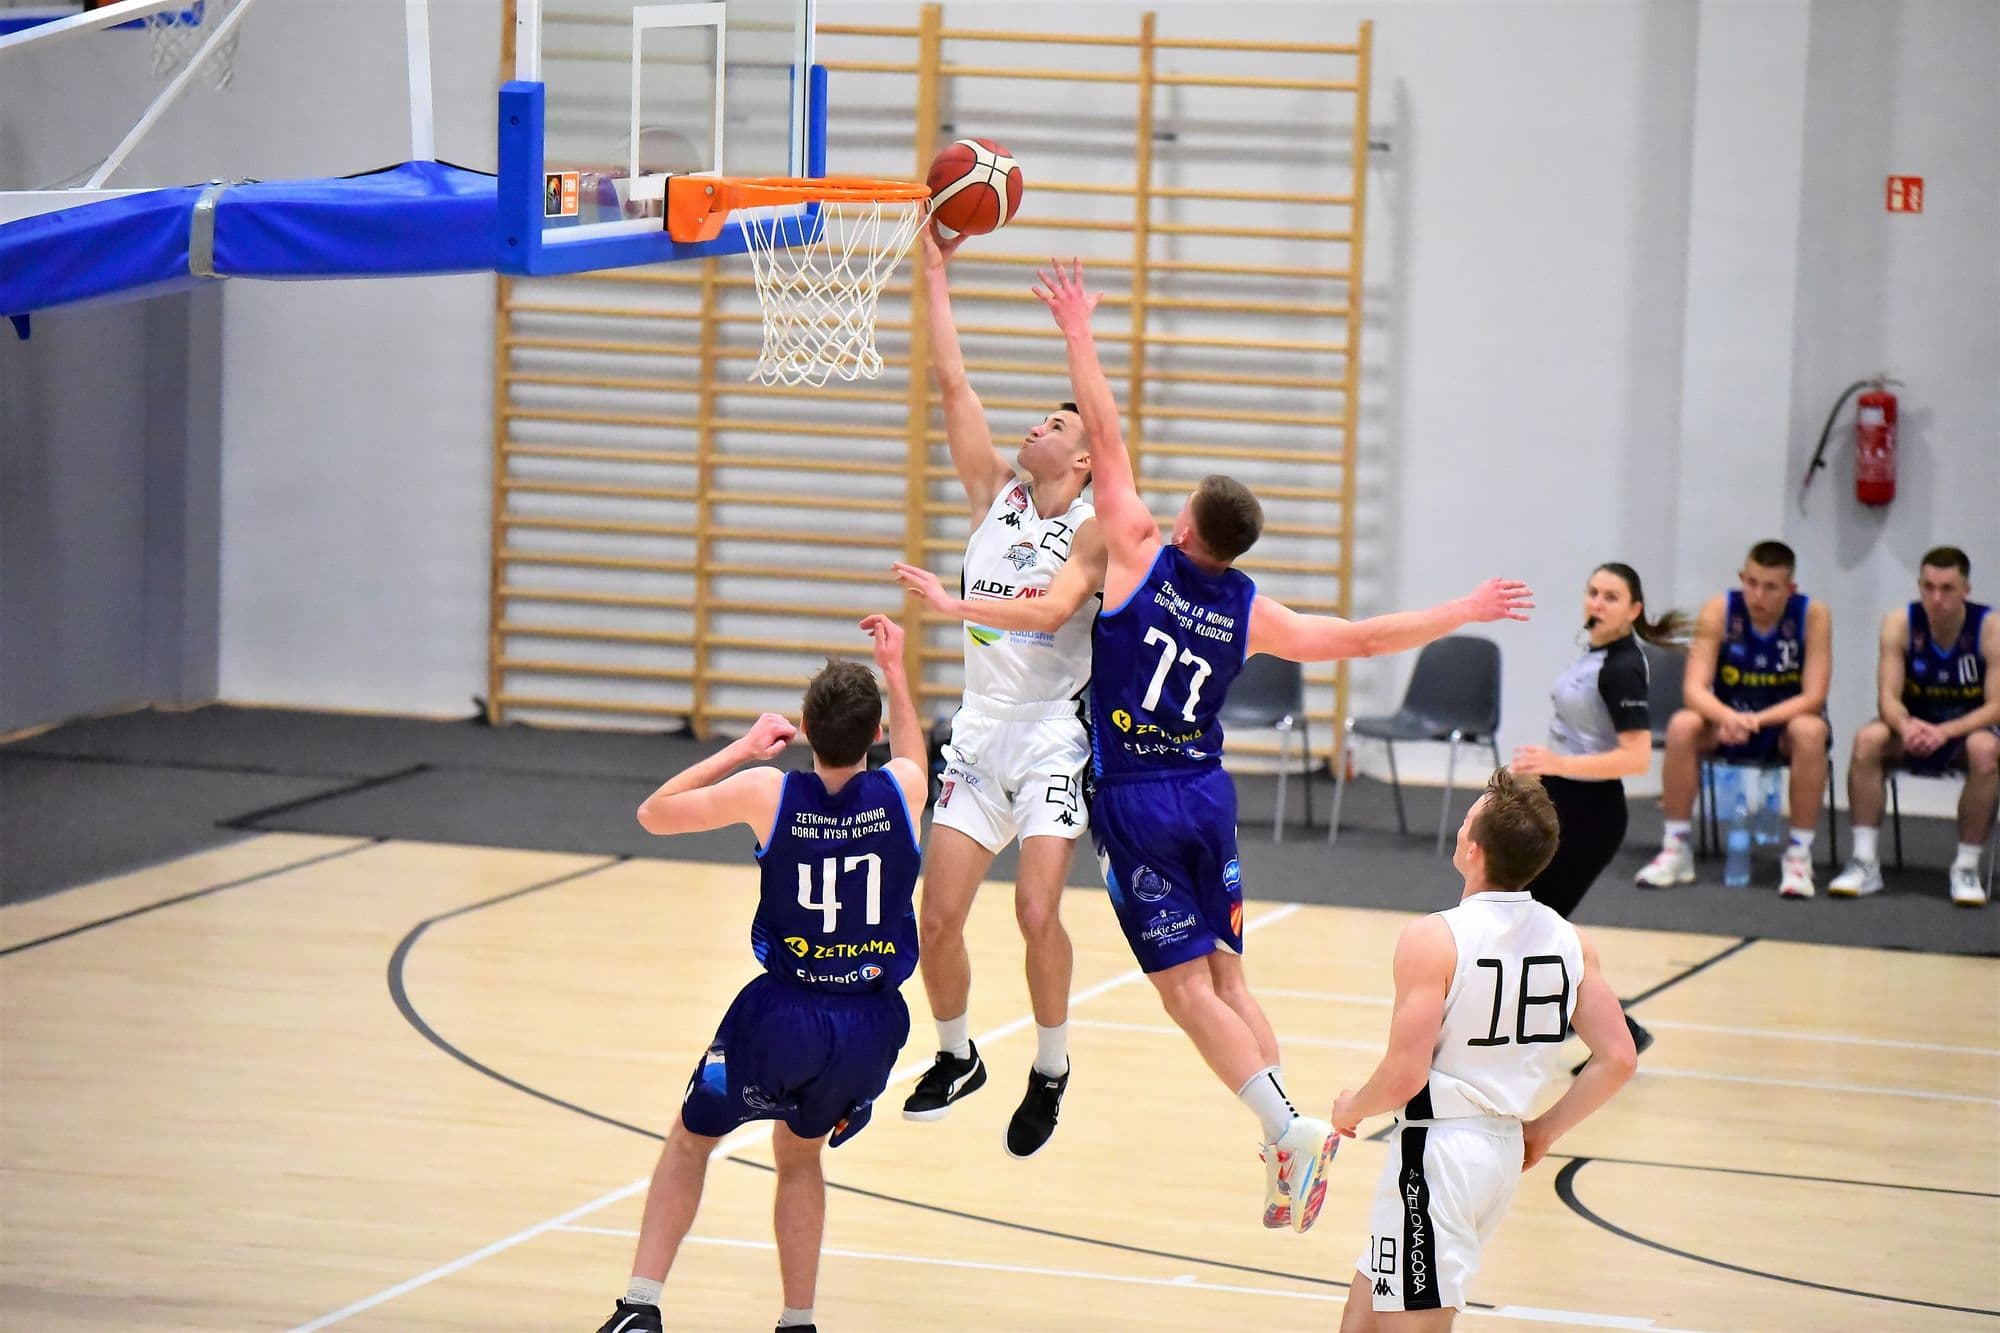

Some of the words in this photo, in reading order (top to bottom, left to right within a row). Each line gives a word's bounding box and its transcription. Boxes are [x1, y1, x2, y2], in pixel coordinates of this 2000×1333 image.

[1191, 605, 1204, 619] LA
[1205, 611, 1235, 629] NONNA
[1141, 626, 1212, 723] 77
[1958, 653, 1979, 685] 10
[1046, 775, 1078, 812] 23
[791, 825, 820, 839] DORAL
[823, 828, 848, 840] NYSA
[852, 820, 891, 839] KŁODZKO
[796, 812, 838, 826] ZETKAMA
[841, 816, 853, 827] LA
[855, 807, 886, 825] NONNA
[797, 853, 882, 933] 47
[813, 940, 896, 959] ZETKAMA
[1467, 955, 1570, 1046] 18
[1406, 1182, 1425, 1249] ZIELONA
